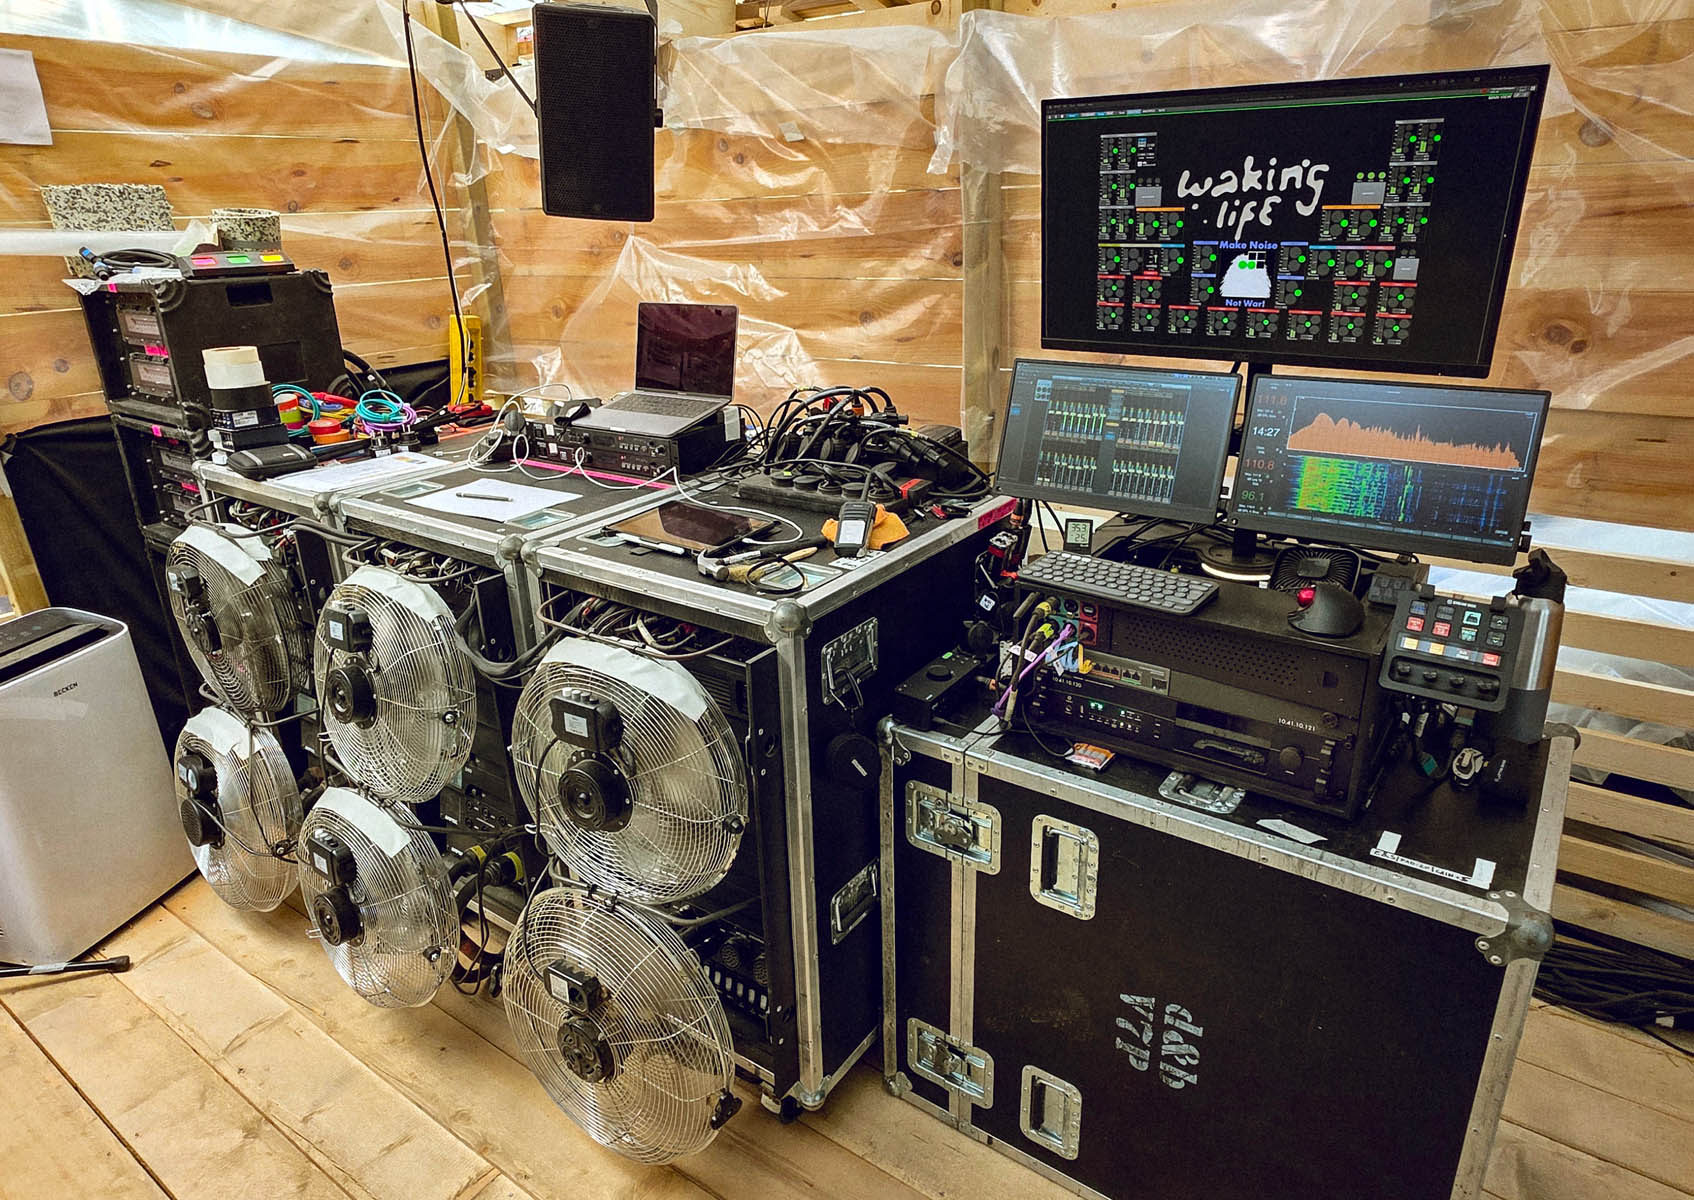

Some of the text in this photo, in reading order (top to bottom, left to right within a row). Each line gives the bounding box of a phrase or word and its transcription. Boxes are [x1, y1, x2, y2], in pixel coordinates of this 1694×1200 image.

[1177, 155, 1330, 217] waking
[1216, 195, 1283, 241] life
[1219, 240, 1279, 250] Make Noise
[1225, 298, 1242, 307] Not
[1252, 426, 1281, 438] 14:27
[1278, 716, 1316, 732] 10.41.10.121
